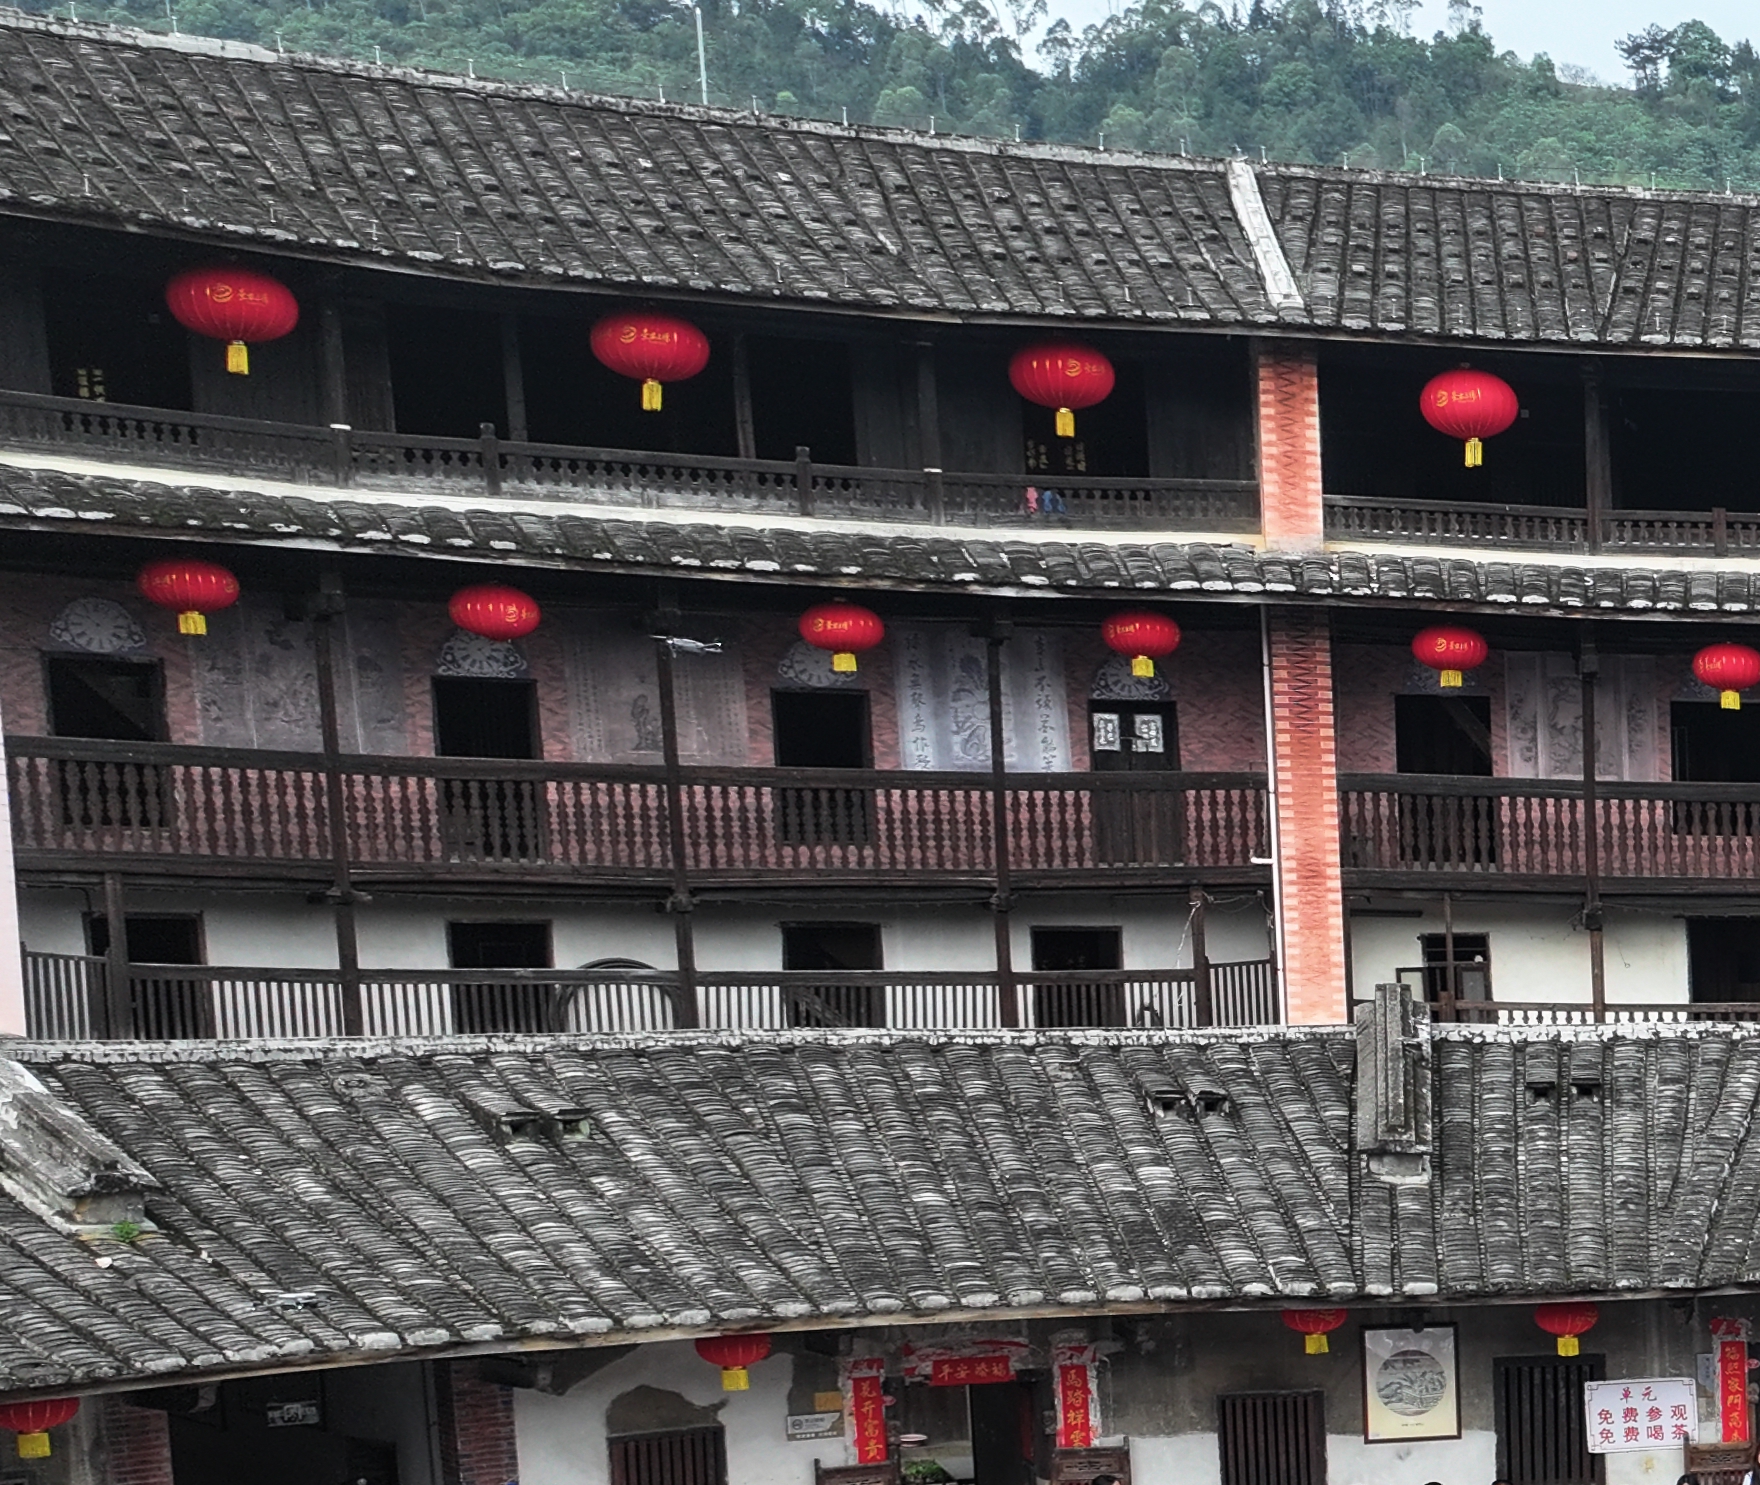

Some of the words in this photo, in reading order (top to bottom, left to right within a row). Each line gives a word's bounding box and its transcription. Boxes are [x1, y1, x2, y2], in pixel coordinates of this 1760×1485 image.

[1620, 1386, 1657, 1403] 单元
[1597, 1404, 1688, 1426] 免费参观
[1597, 1423, 1689, 1445] 免费喝茶
